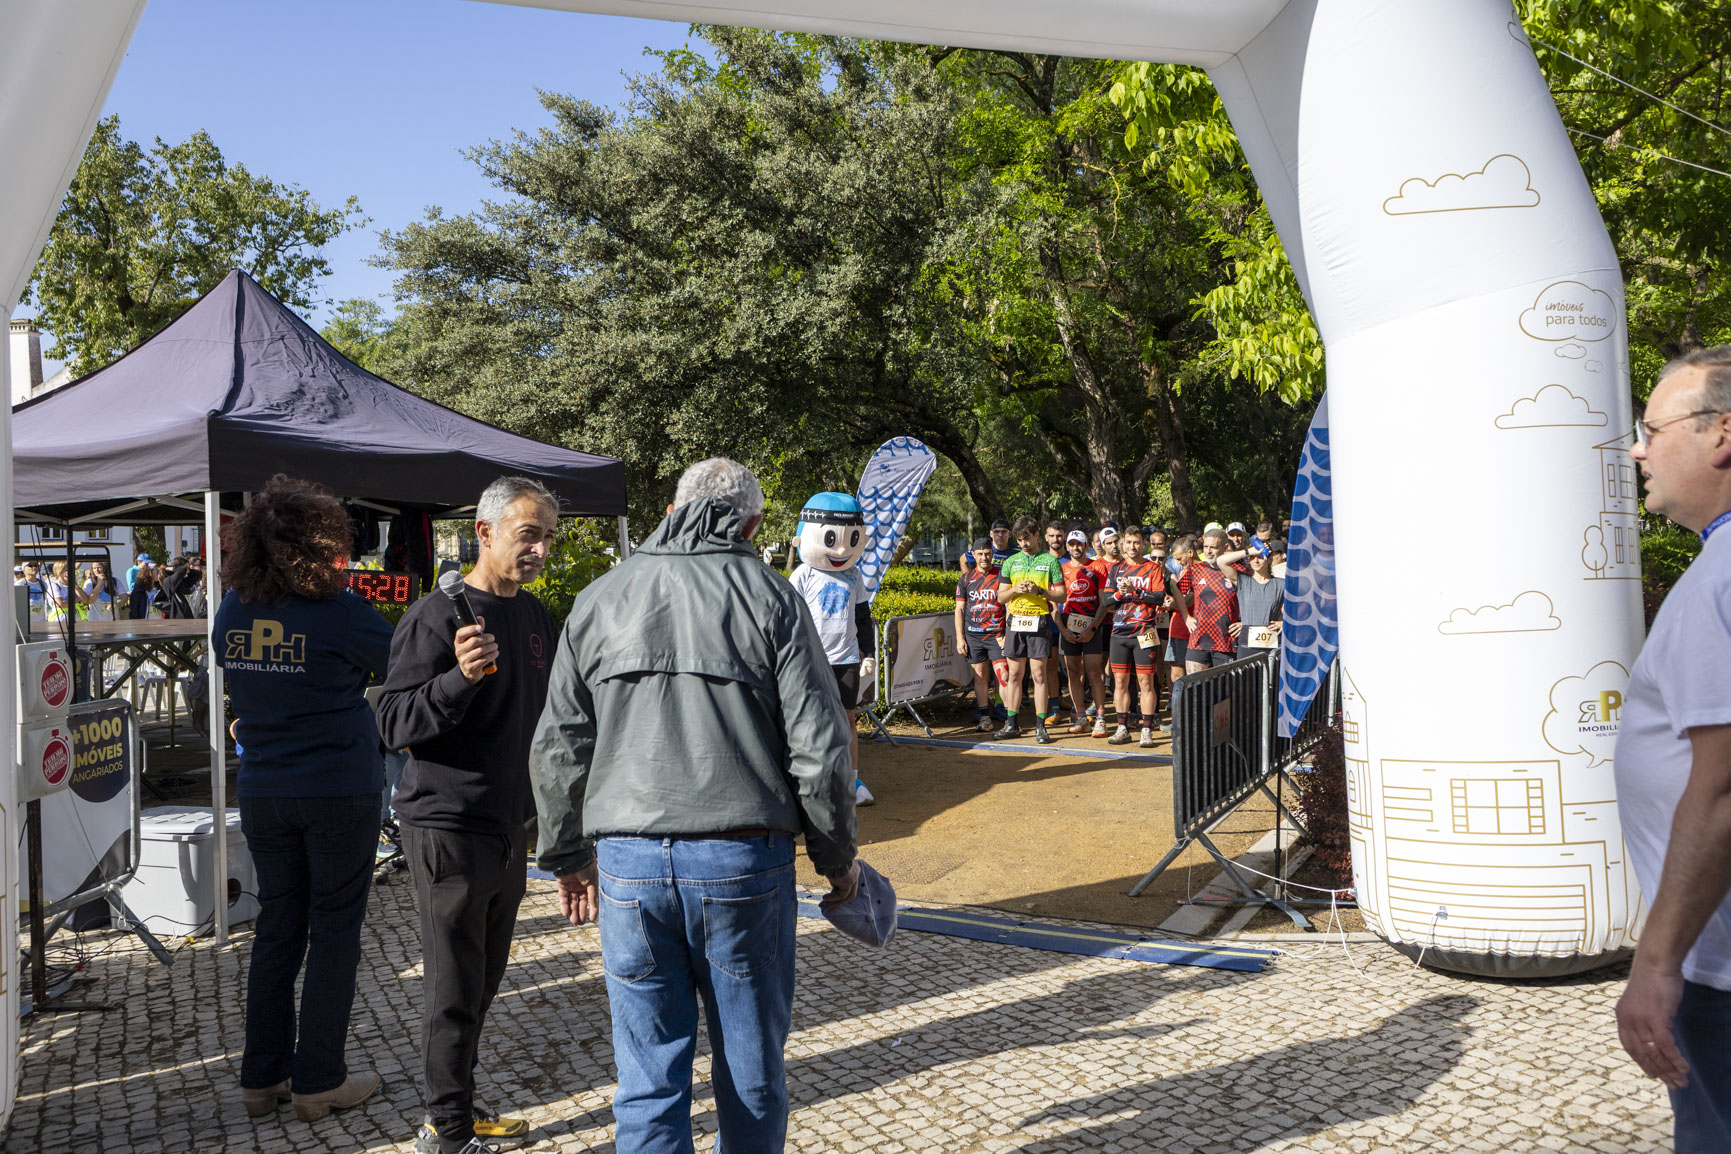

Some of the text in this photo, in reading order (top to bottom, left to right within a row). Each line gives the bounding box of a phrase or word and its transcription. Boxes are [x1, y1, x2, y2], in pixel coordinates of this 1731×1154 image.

[1545, 300, 1584, 312] imóveis
[1546, 314, 1607, 327] para todos
[1017, 619, 1033, 627] 186
[1073, 618, 1088, 629] 166
[1255, 632, 1273, 642] 207
[225, 661, 306, 673] IMOBILIÁRIA
[71, 716, 123, 746] +1000
[1578, 725, 1620, 733] IMOBILI
[73, 742, 123, 770] IMÓVEIS
[72, 760, 123, 784] ANGARIADOS
